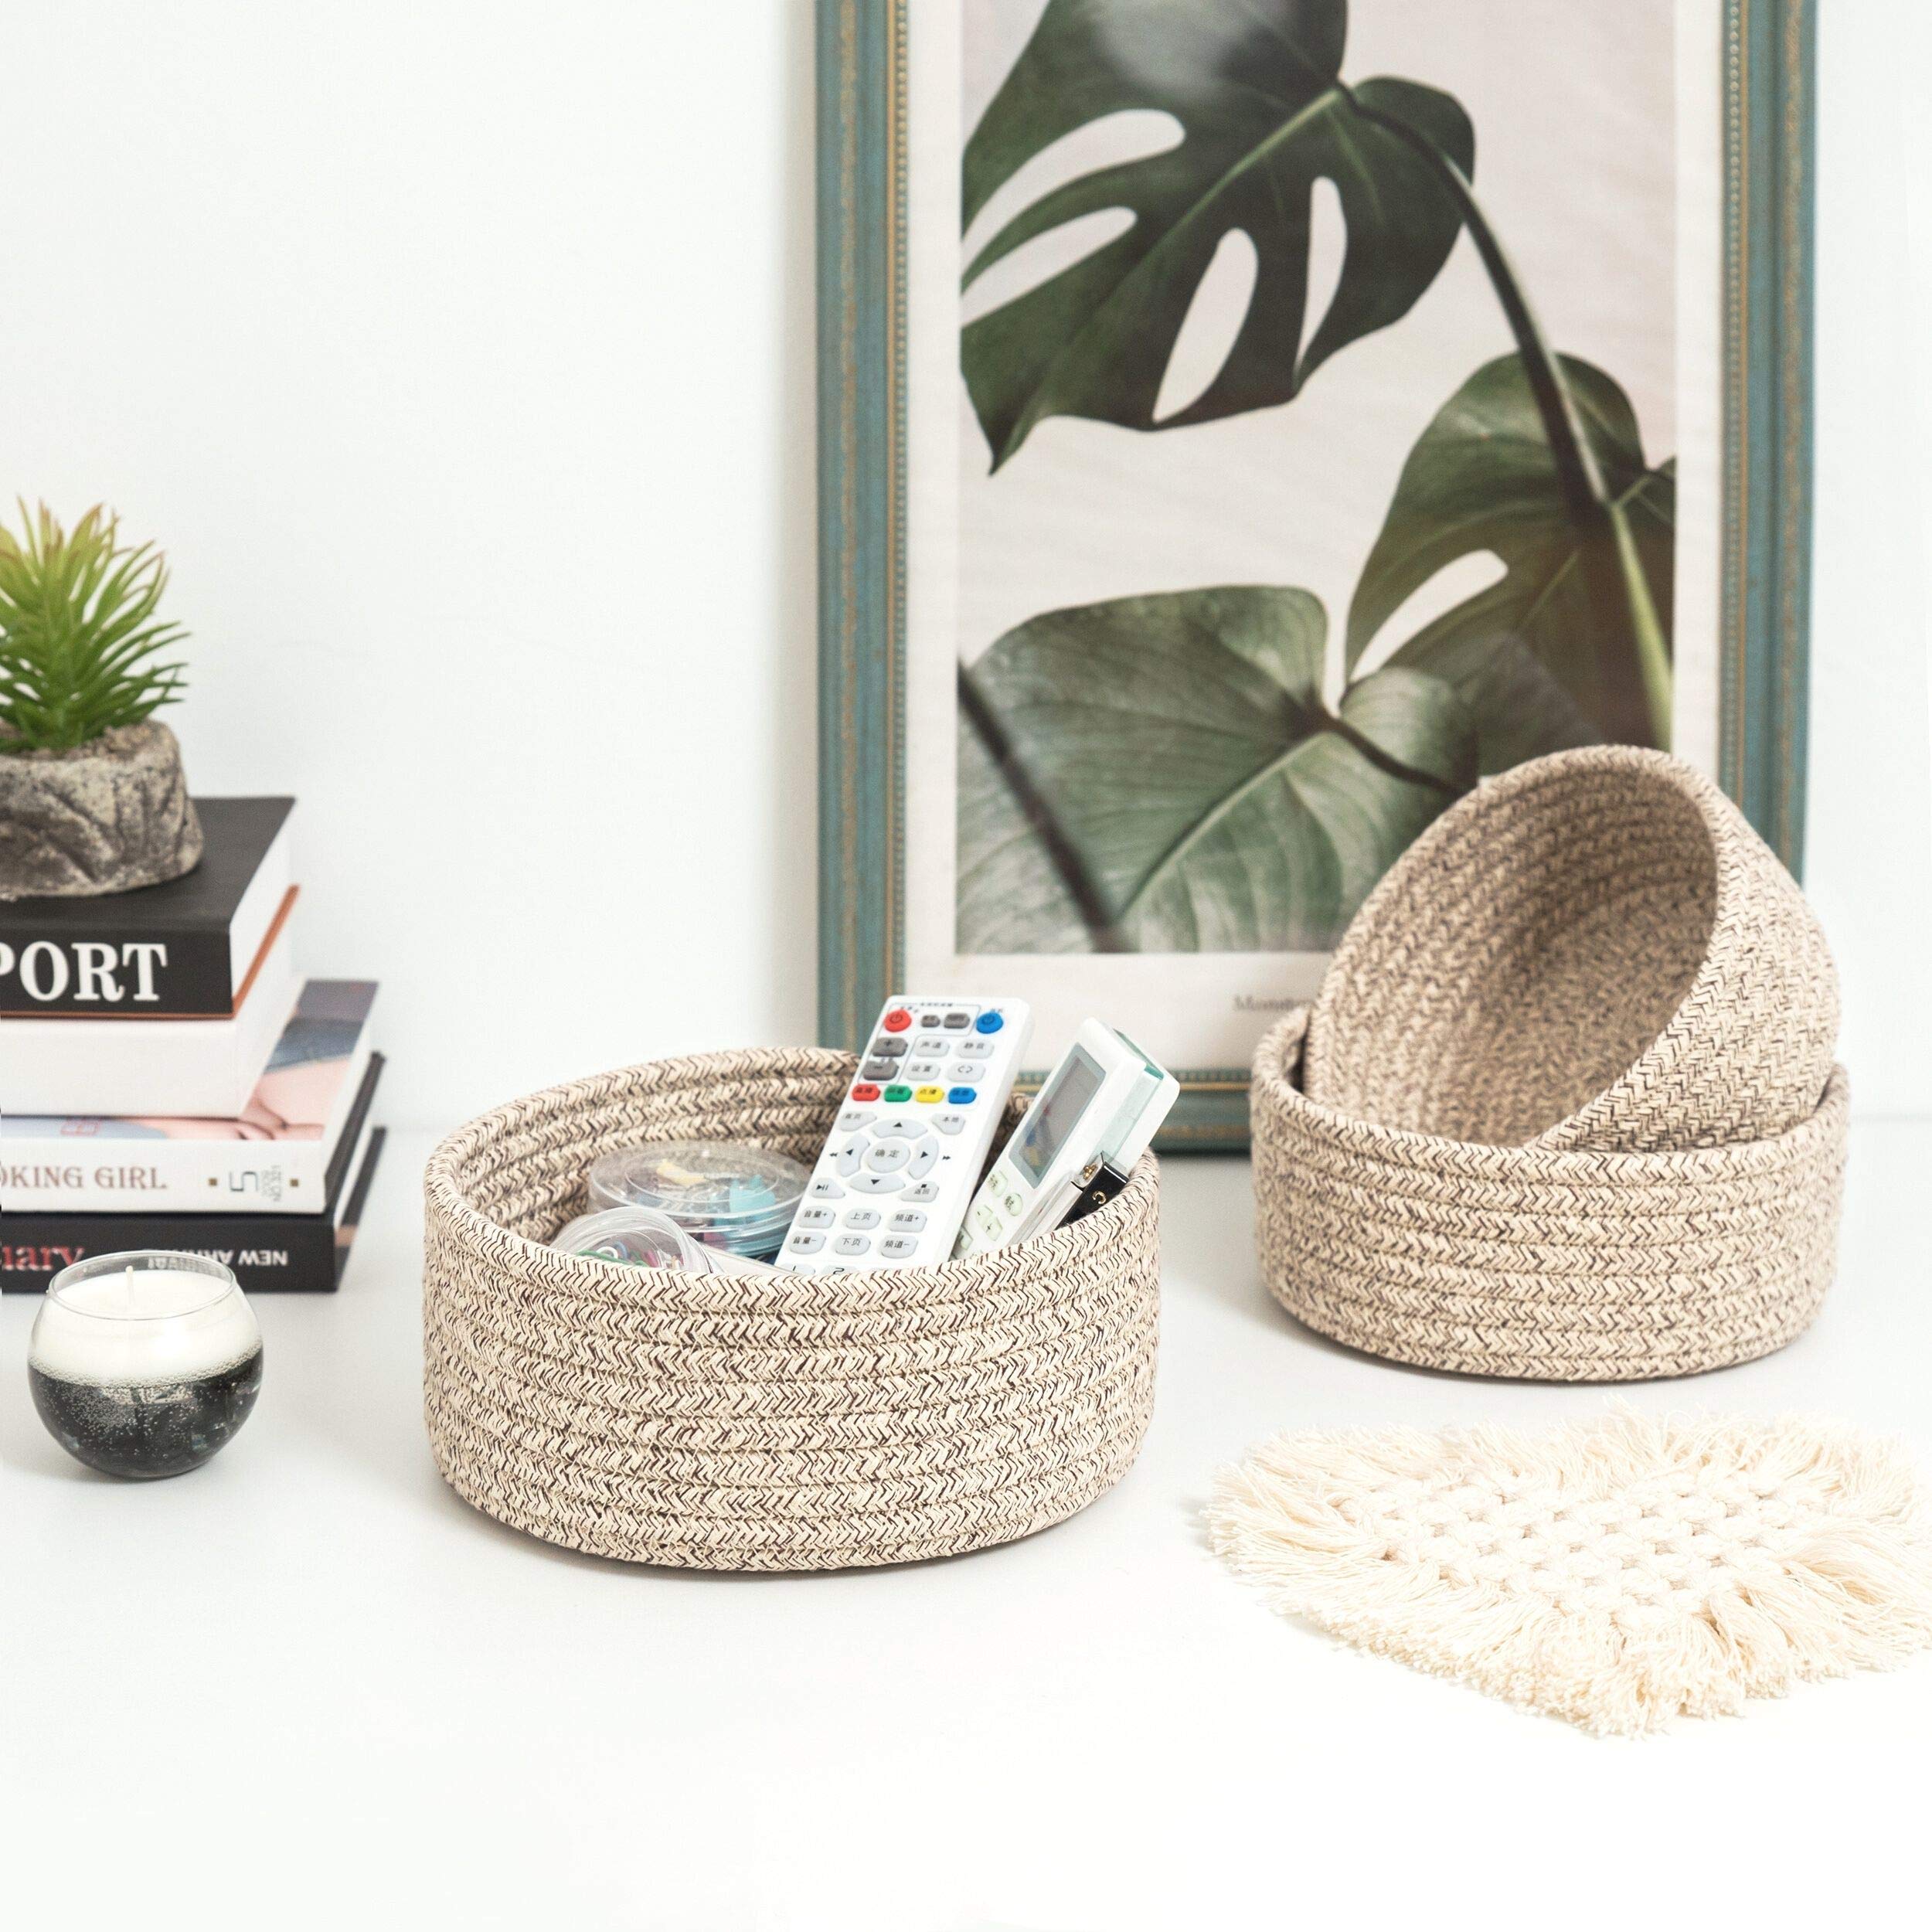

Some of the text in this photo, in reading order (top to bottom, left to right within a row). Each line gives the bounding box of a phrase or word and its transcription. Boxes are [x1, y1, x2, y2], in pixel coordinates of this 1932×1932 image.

[874, 1148, 900, 1159] 确定
[94, 1166, 167, 1190] GIRL
[803, 1209, 828, 1219] 音量+
[850, 1211, 872, 1221] 上页
[893, 1213, 920, 1223] 频道+
[842, 1236, 862, 1247] 下页
[238, 1250, 287, 1266] NEW
